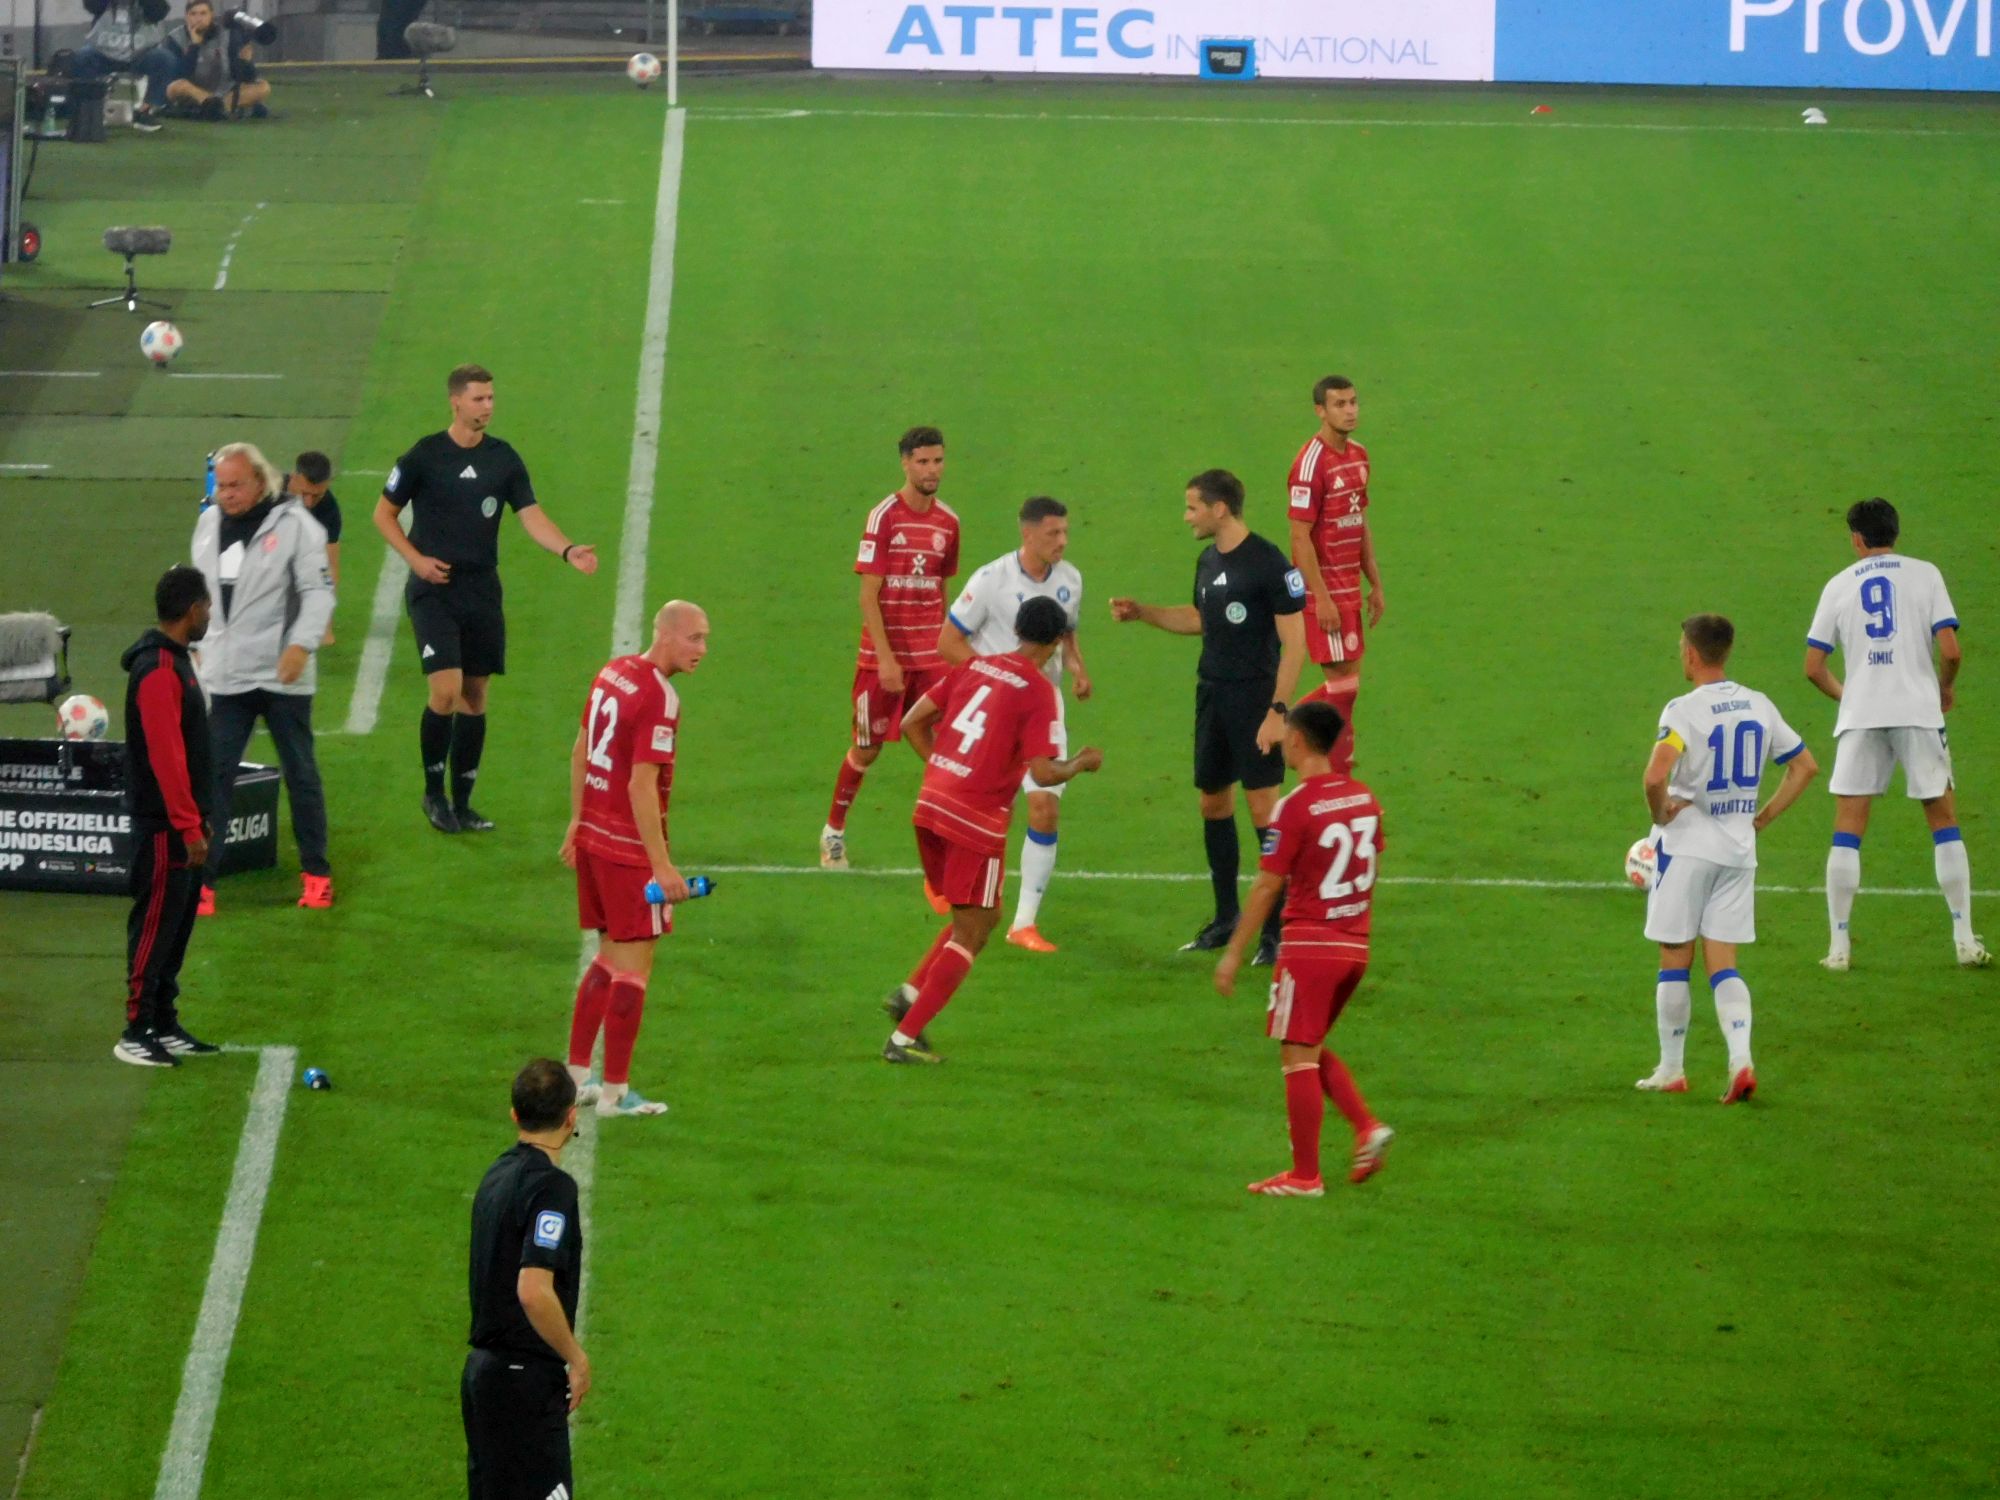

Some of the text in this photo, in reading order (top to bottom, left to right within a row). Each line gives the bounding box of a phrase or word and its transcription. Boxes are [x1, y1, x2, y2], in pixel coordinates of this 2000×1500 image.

[885, 4, 1438, 66] ATTEC INNATIONAL
[1860, 575, 1897, 643] 9
[587, 687, 619, 773] 12
[950, 685, 993, 755] 4
[1706, 720, 1765, 793] 10
[18, 811, 131, 833] OFFIZIELLE
[1317, 815, 1379, 900] 23
